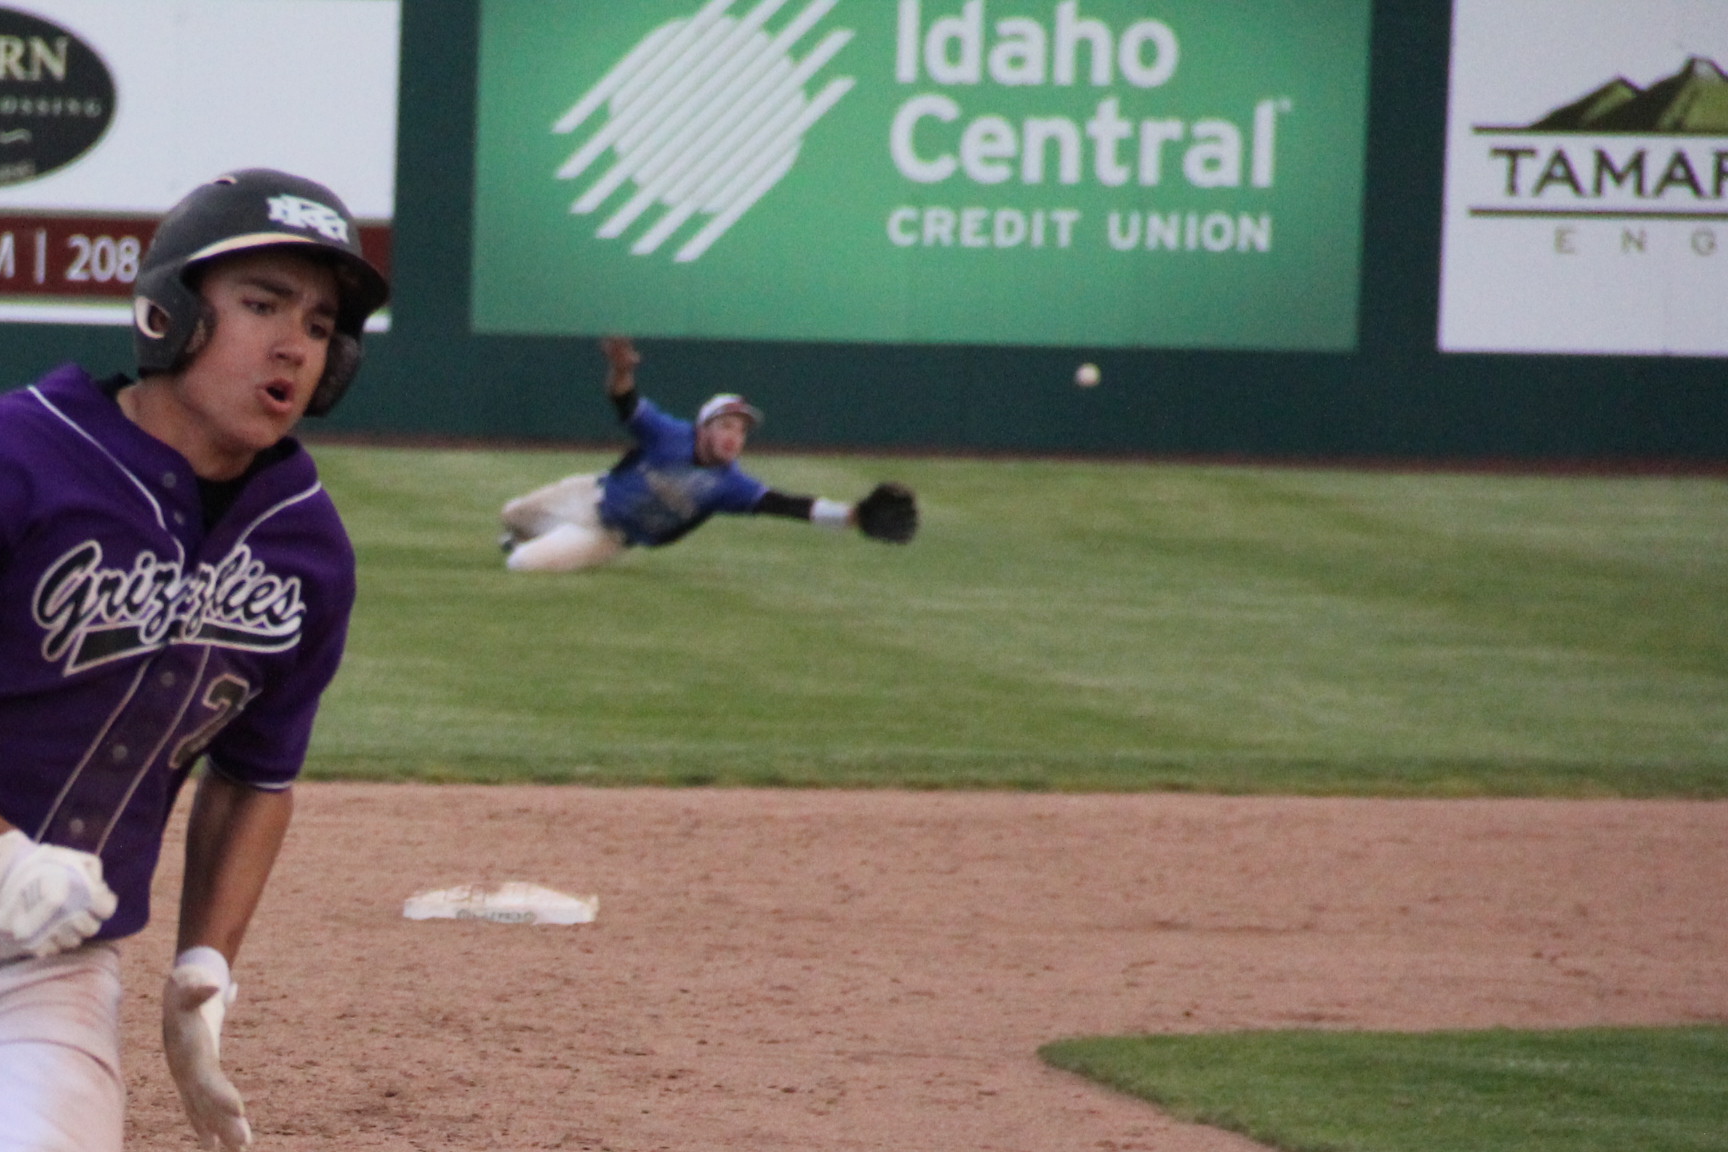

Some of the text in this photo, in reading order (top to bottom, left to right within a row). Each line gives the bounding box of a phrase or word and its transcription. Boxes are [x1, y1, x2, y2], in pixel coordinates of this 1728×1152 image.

[895, 0, 1178, 88] Idaho
[889, 94, 1277, 187] Central
[66, 233, 141, 283] 208
[886, 207, 1272, 252] CREDIT UNION
[32, 540, 307, 664] Grizzlies
